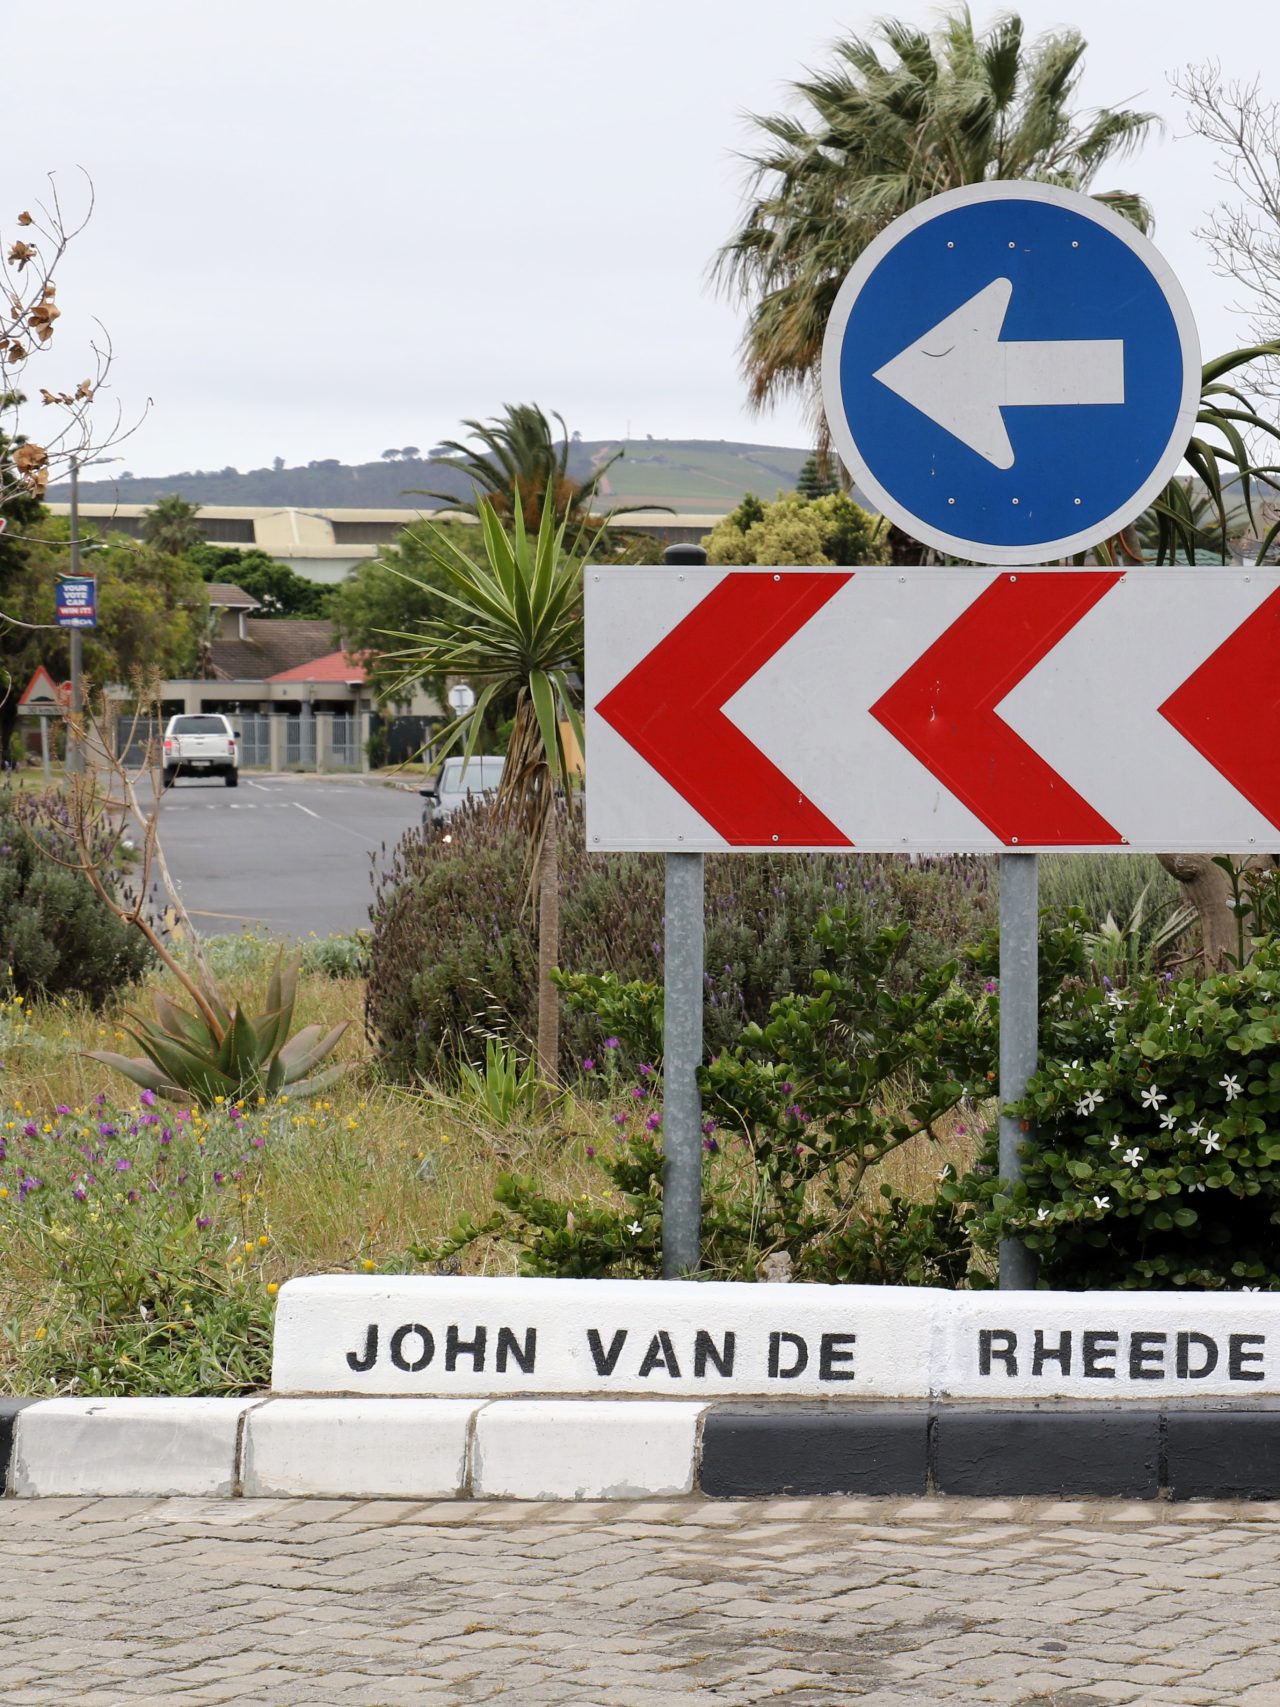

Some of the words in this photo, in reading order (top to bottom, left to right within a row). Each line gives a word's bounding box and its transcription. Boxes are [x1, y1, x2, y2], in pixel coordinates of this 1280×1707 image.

[347, 1324, 537, 1374] JOHN
[588, 1329, 735, 1378] VAN
[769, 1332, 856, 1381] DE
[980, 1329, 1266, 1381] RHEEDE
